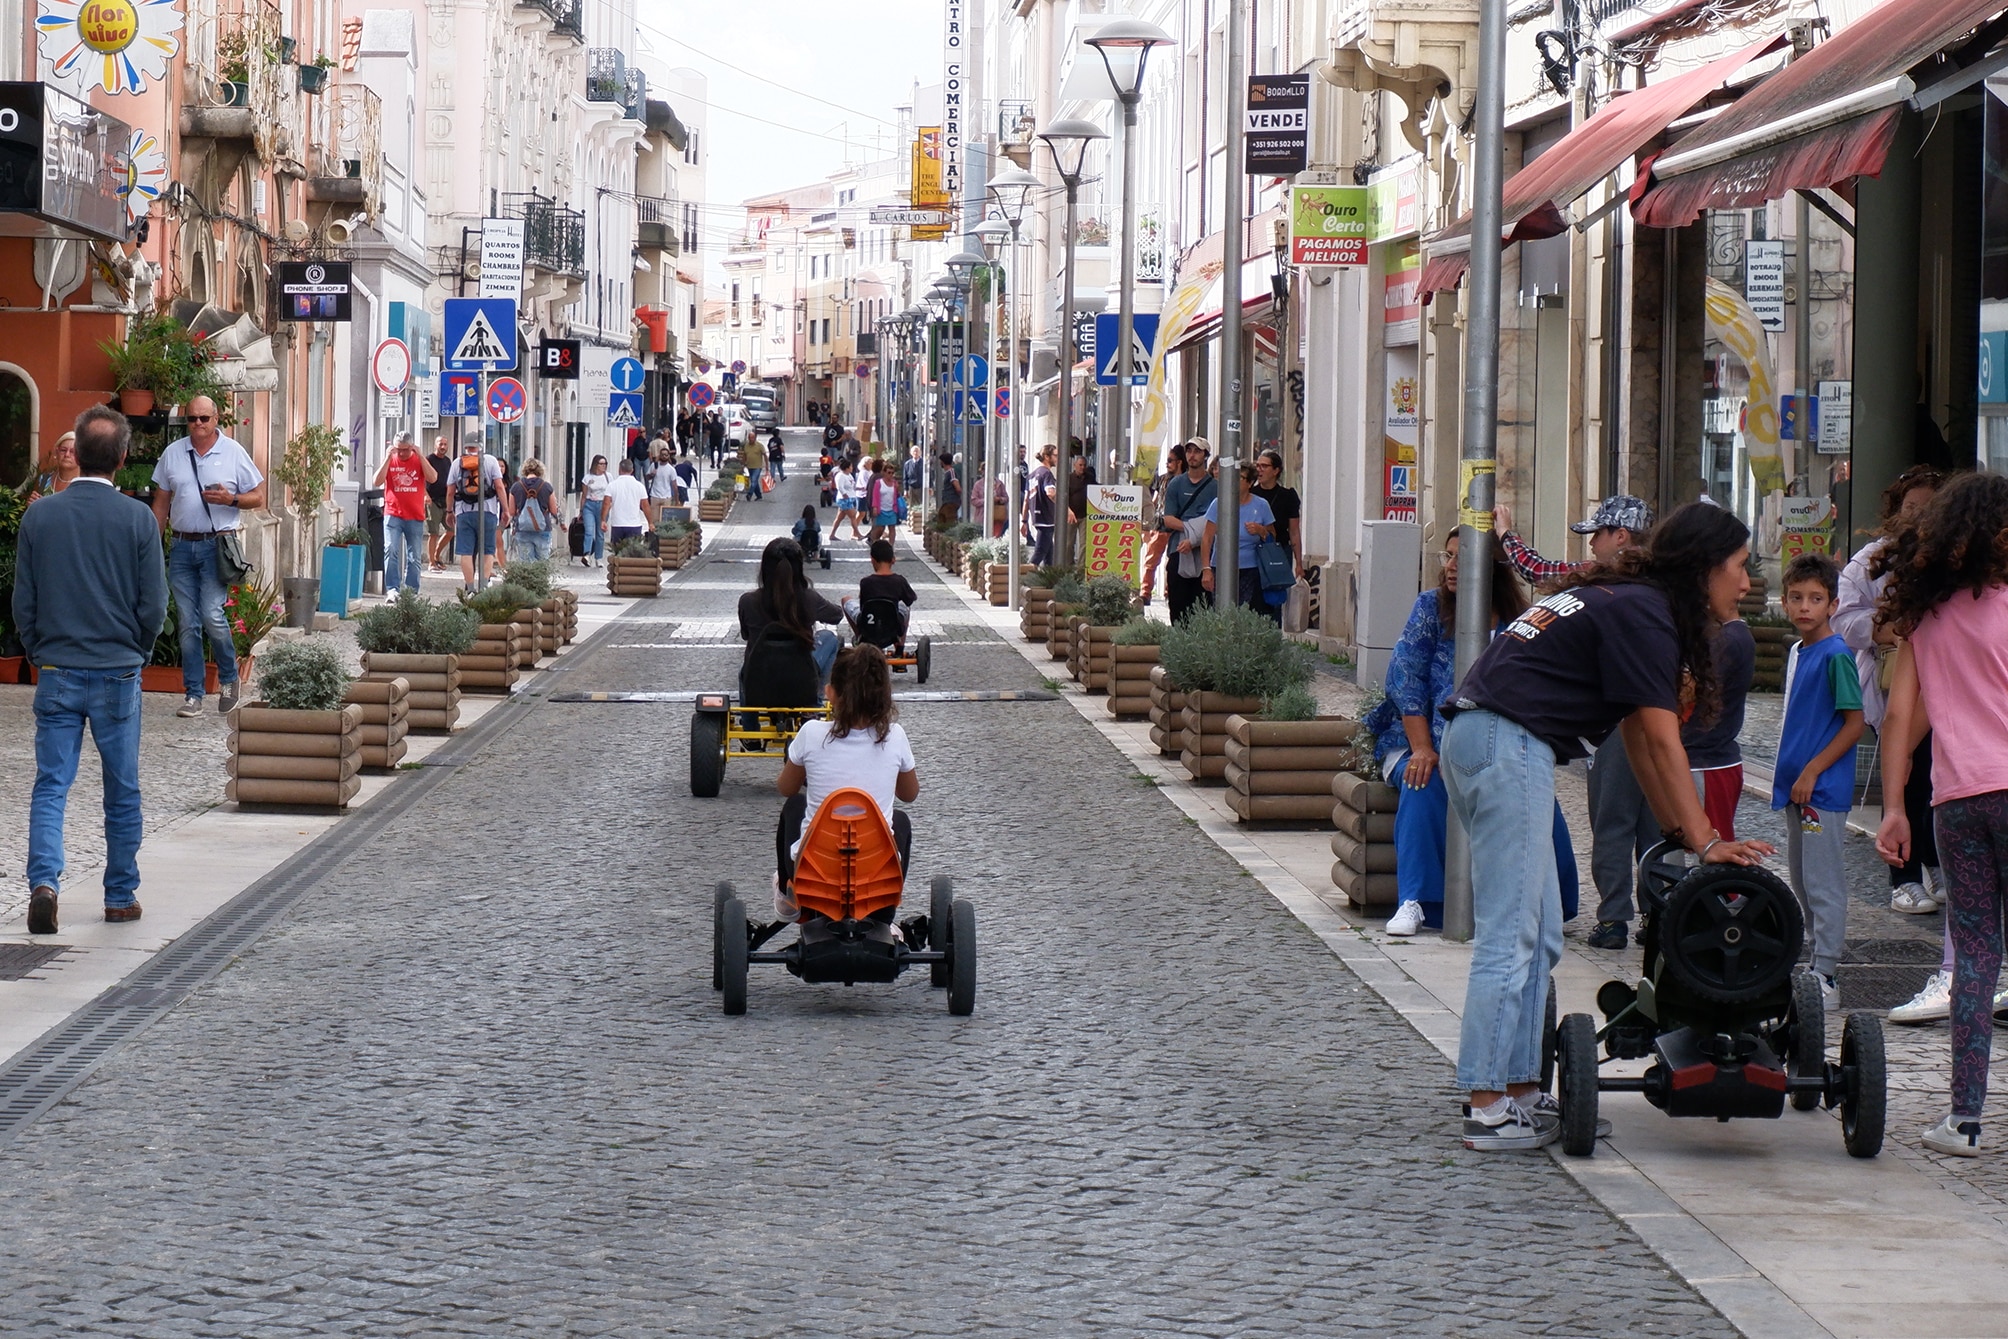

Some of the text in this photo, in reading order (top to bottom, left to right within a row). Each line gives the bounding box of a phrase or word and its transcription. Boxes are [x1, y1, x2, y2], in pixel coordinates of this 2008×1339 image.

[87, 4, 125, 23] flor
[1266, 87, 1305, 97] BORDALLO
[1249, 113, 1303, 128] VENDE
[946, 64, 960, 190] COMERCIAL
[1267, 140, 1278, 148] 926
[1279, 140, 1291, 148] 502
[1324, 203, 1357, 216] Ouro
[885, 213, 927, 222] CARLOS
[1322, 215, 1365, 233] Certo
[485, 241, 520, 249] QUARTOS
[1298, 238, 1363, 250] PAGAMOS
[1302, 251, 1358, 263] MELHOR
[482, 262, 520, 270] CHAMBRES
[1114, 494, 1135, 503] Ouro
[1114, 502, 1139, 512] Certo
[1088, 513, 1139, 521] COMPRAMOS
[1091, 522, 1110, 571] OURO
[866, 613, 875, 625] 2
